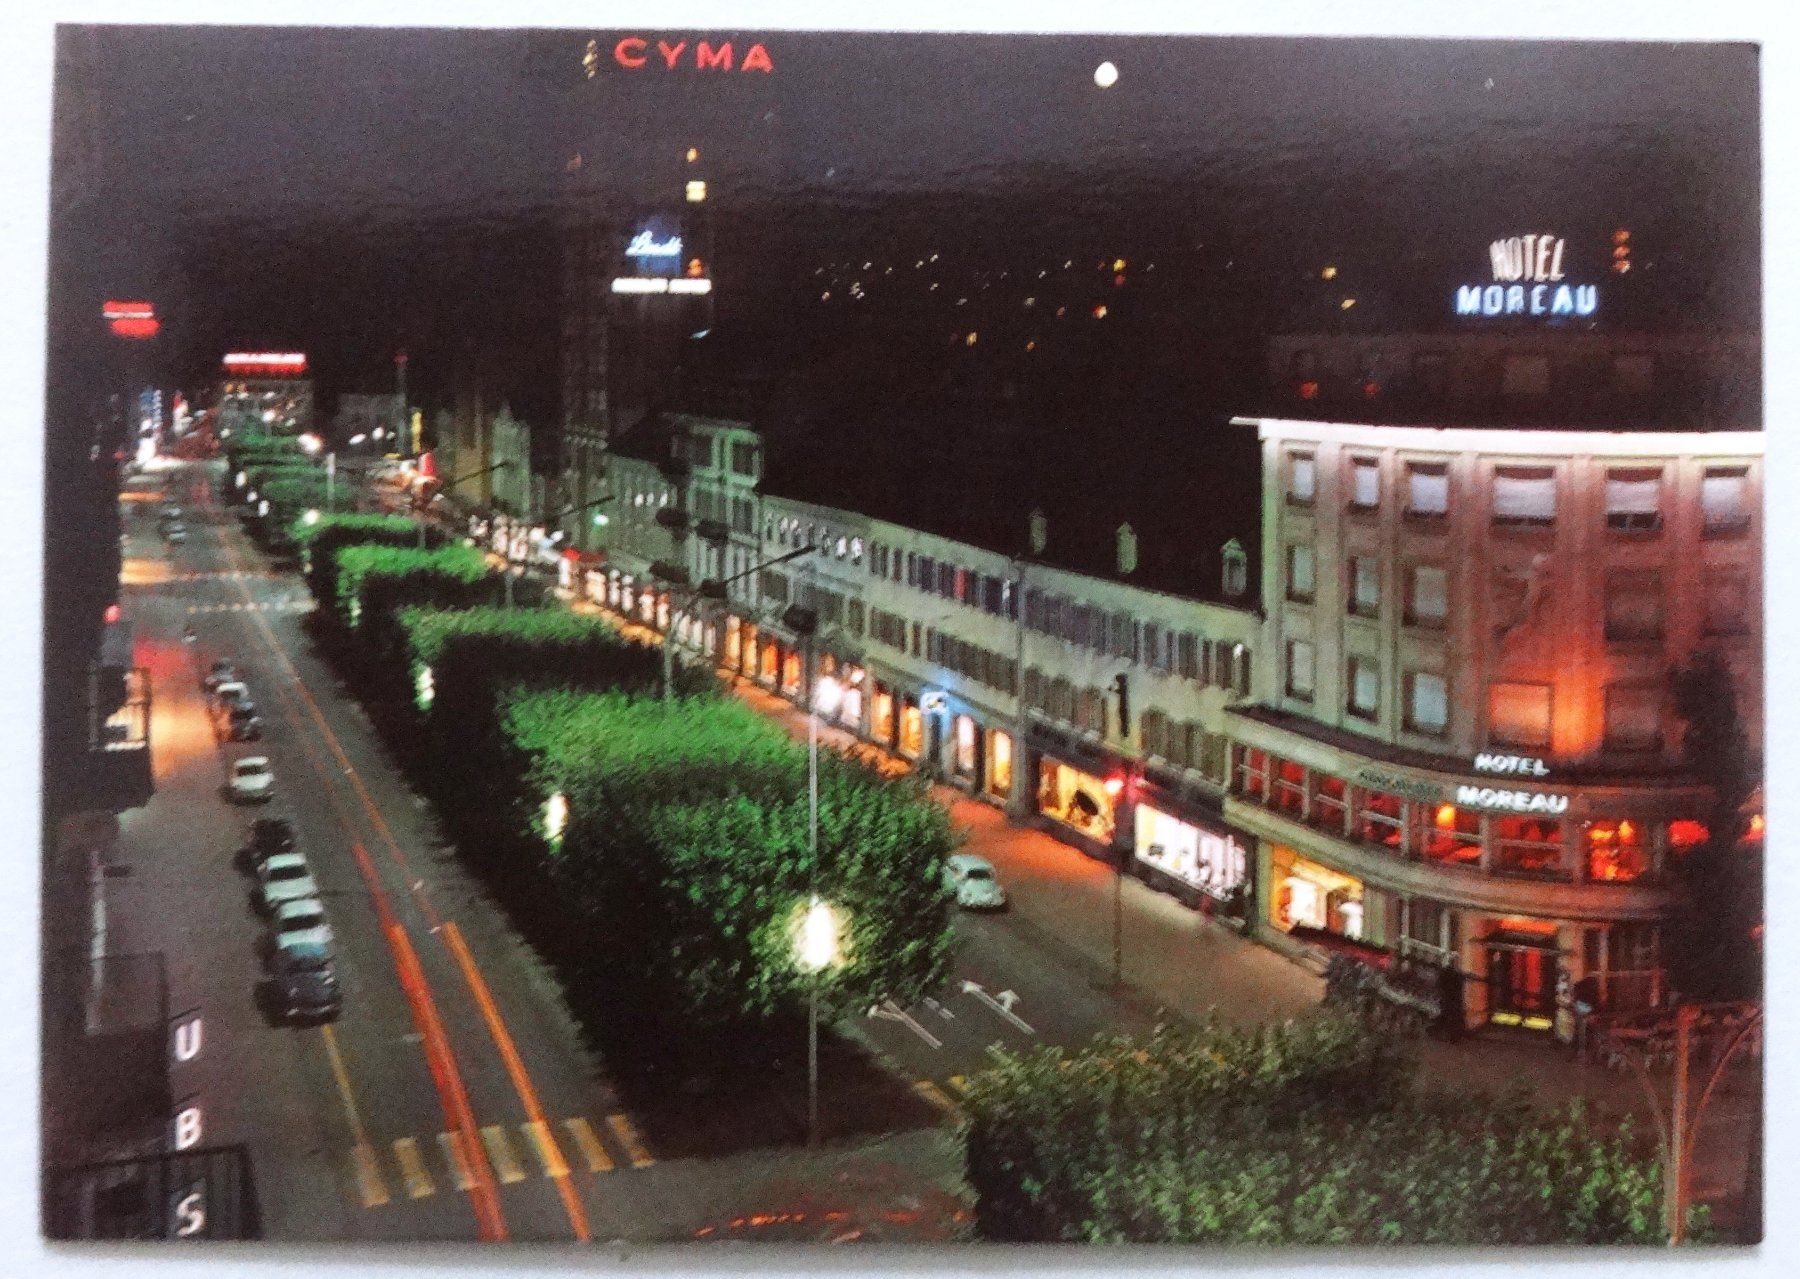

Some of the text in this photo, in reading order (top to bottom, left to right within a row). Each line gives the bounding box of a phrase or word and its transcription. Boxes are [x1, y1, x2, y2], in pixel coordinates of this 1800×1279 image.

[614, 37, 774, 73] CYMA
[1489, 233, 1566, 281] HOTEL
[1456, 284, 1598, 315] MOREAU
[1474, 753, 1550, 776] HOTEL
[1456, 785, 1568, 814] MOREAU
